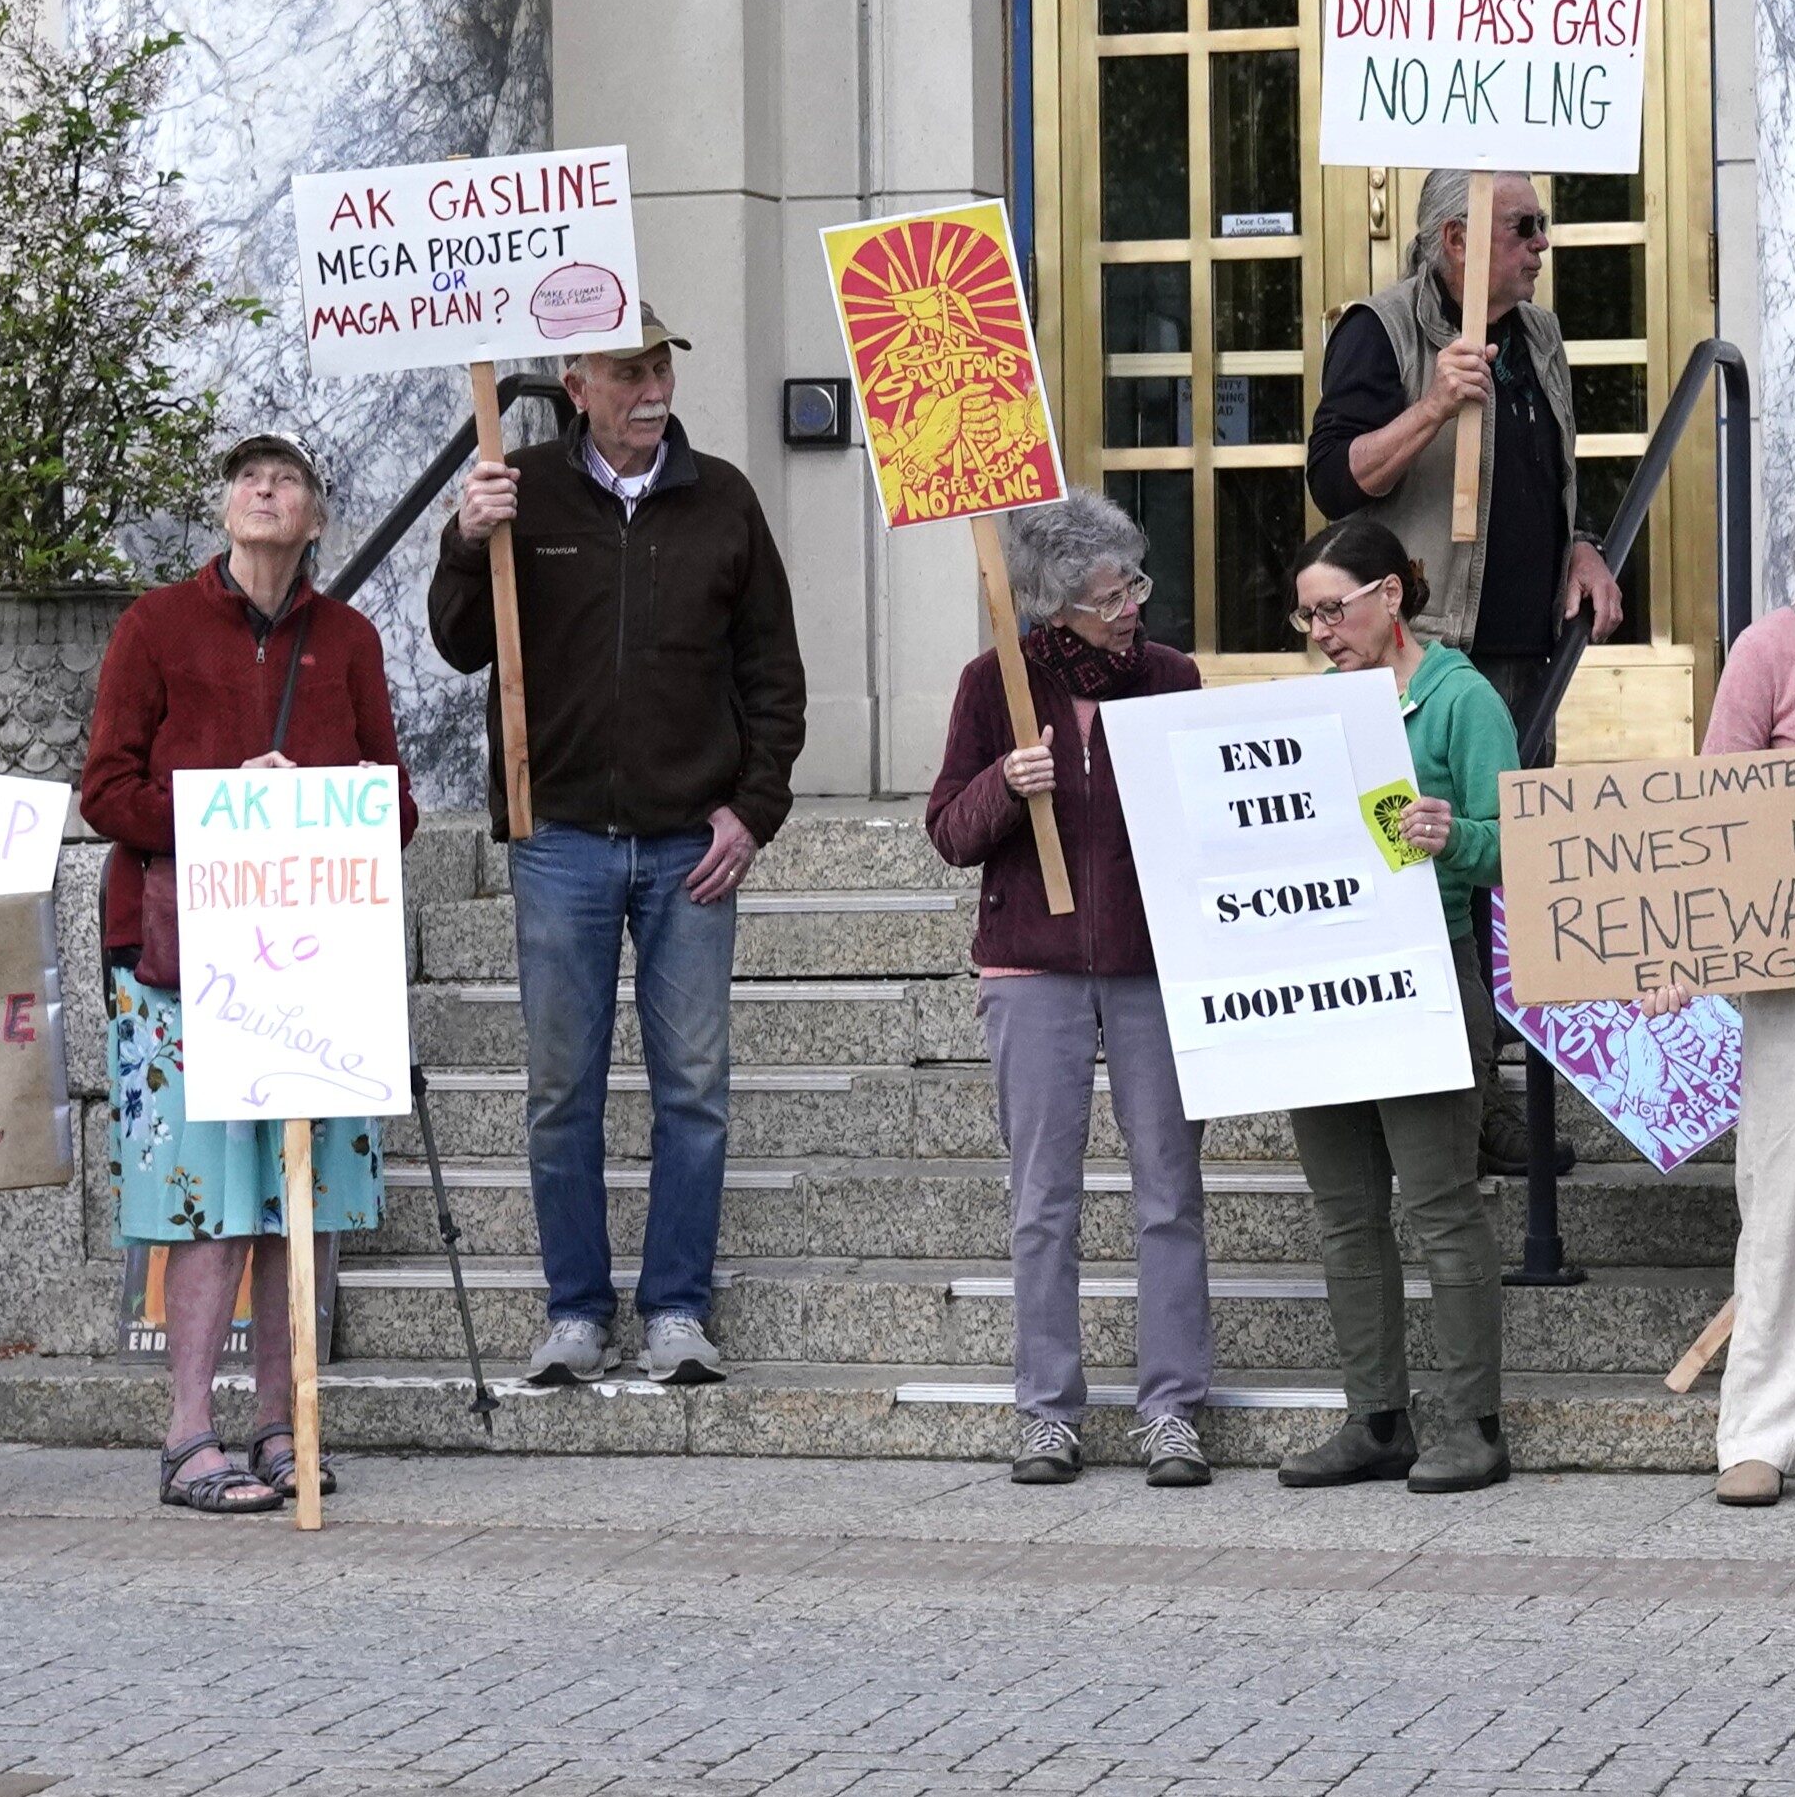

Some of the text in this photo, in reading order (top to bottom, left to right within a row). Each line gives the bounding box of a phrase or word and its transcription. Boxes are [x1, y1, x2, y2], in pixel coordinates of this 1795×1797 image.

[1359, 56, 1612, 129] NO AK LNG
[329, 162, 618, 232] AK GASLINE
[317, 224, 571, 285] MEGA PROJECT
[432, 269, 467, 292] OR
[311, 302, 400, 341] MAGA
[886, 334, 988, 372] REAL
[889, 449, 931, 490] NOT
[974, 430, 1037, 490] DREAMS
[901, 485, 950, 520] NO
[1218, 737, 1302, 773] END
[200, 777, 392, 830] AK LNG
[1228, 791, 1316, 828] THE
[1512, 778, 1574, 820] IN
[1594, 776, 1628, 810] A
[1548, 821, 1749, 884] INVEST
[187, 855, 390, 911] BRIDGE FUEL
[1215, 877, 1360, 924] S-CORP
[1200, 969, 1418, 1025] LOOPHOLE
[1619, 1096, 1668, 1129] NOT
[1648, 1116, 1708, 1158] NO
